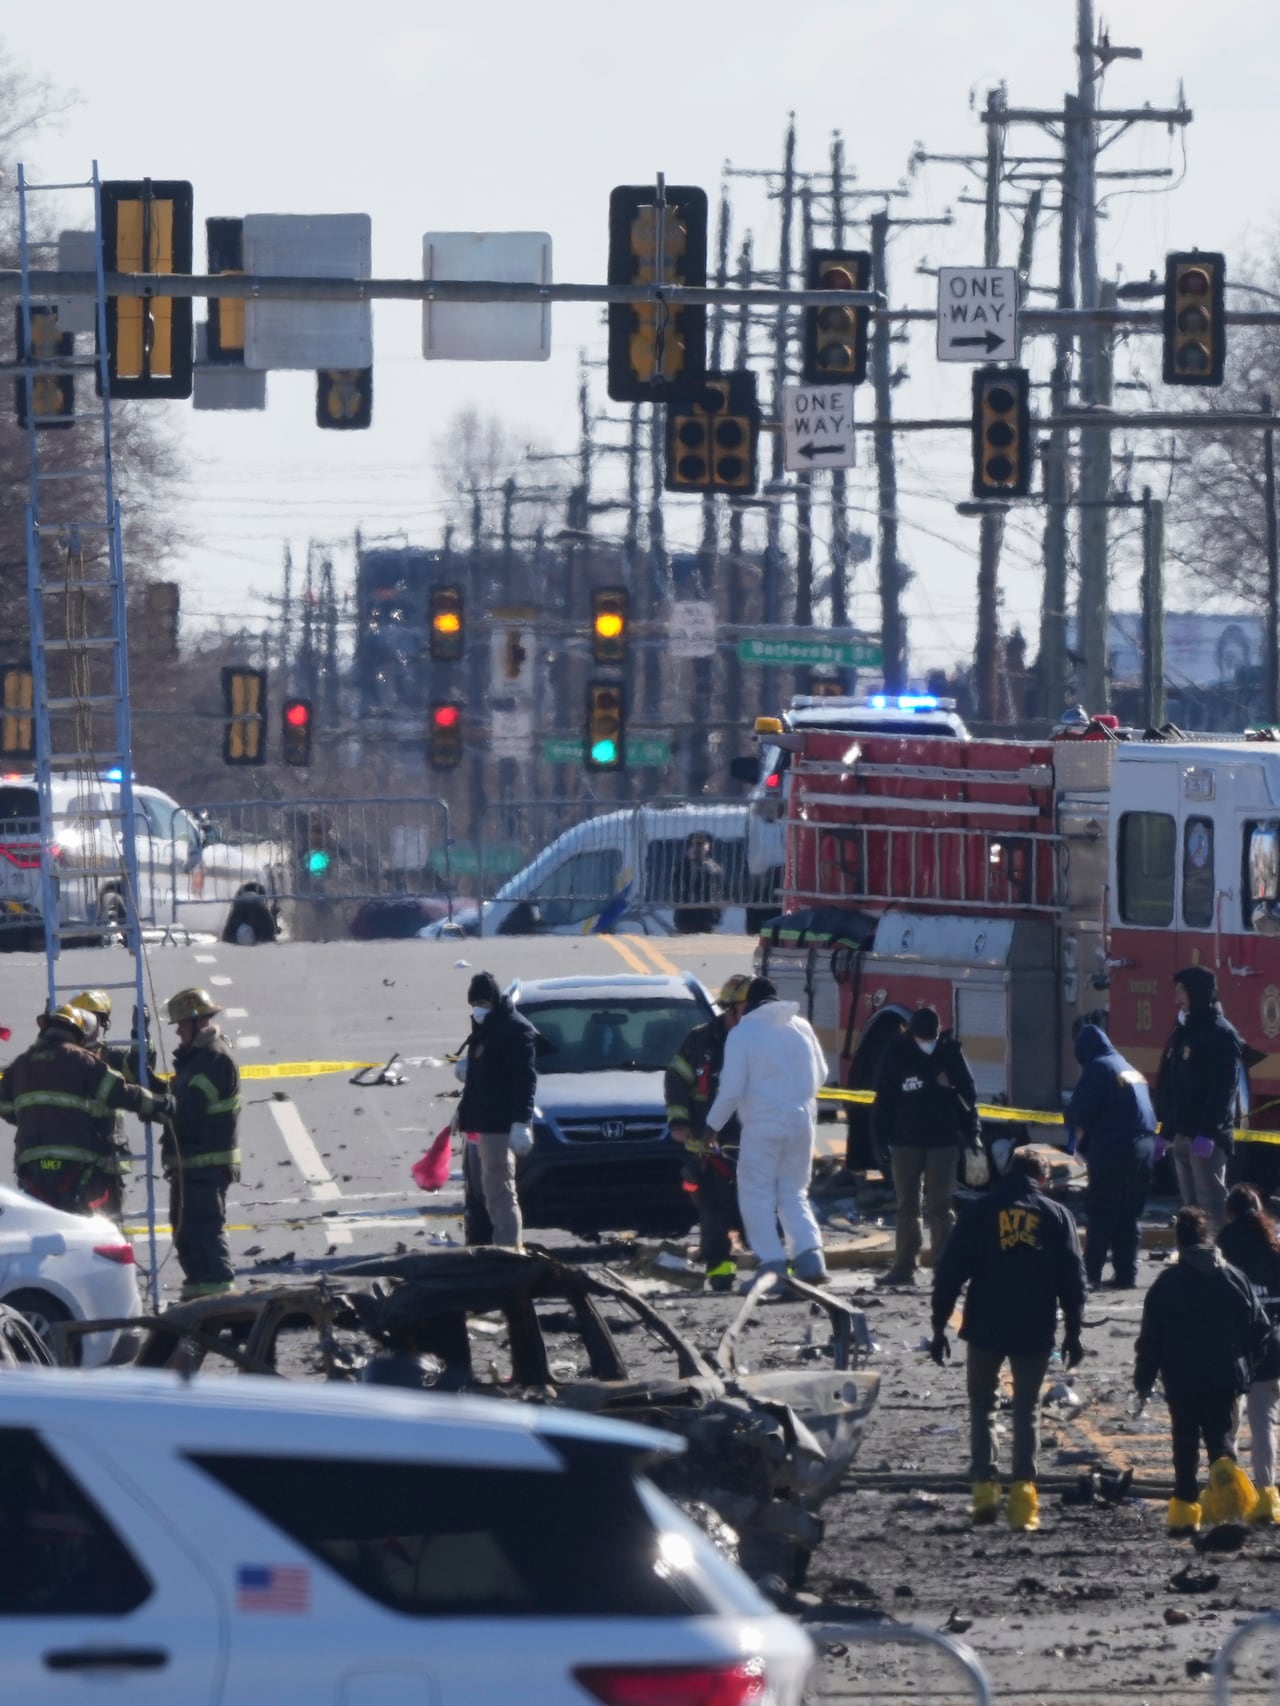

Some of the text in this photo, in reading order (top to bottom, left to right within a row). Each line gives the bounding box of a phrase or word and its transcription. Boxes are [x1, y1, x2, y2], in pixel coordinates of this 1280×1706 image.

[949, 276, 1005, 299] ONE
[949, 303, 1005, 323] WAY
[795, 392, 845, 414] ONE
[794, 414, 845, 435] WAY
[1135, 1000, 1152, 1033] 18
[999, 1209, 1041, 1237] ATF
